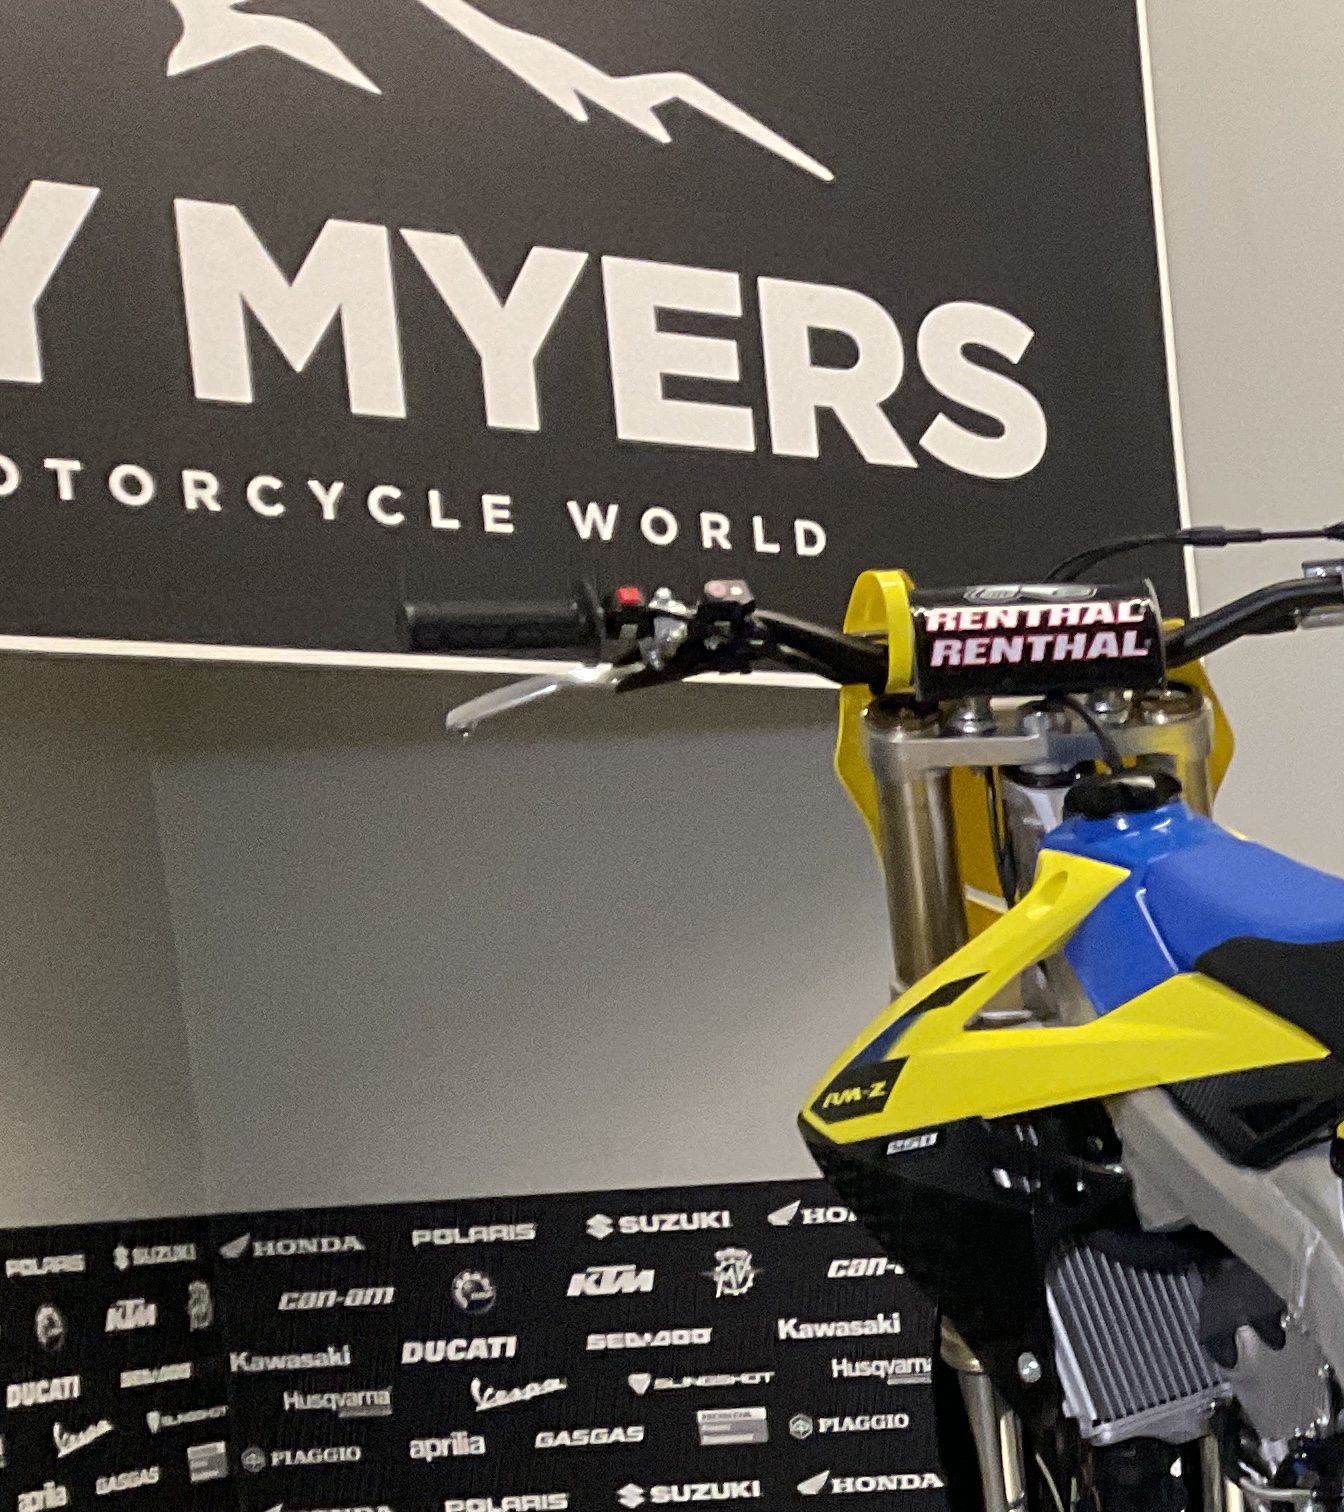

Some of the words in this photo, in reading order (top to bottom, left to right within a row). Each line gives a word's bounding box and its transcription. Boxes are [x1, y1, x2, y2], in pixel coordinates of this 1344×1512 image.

[174, 198, 1047, 480] MYERS
[567, 499, 827, 556] WORLD
[925, 598, 1146, 632] RENTHAL
[930, 631, 1149, 667] RENTHAL
[412, 1223, 536, 1247] POLARIS
[619, 1210, 733, 1233] SUZUKI
[253, 1236, 364, 1256] HONDA
[567, 1264, 655, 1296] KTM
[105, 1298, 156, 1332] KTM
[778, 1312, 901, 1339] Kawasaki
[230, 1345, 351, 1372] Kawasaki
[402, 1335, 517, 1363] DUCATI
[832, 1358, 932, 1380] Husqvarn
[6, 1375, 80, 1408] DUCATI
[284, 1386, 392, 1411] Husqvarna
[818, 1413, 909, 1432] PIAGGIO
[410, 1431, 486, 1462] aprilia
[535, 1426, 644, 1448] GASGAS
[271, 1446, 361, 1466] PIAGGIO
[650, 1480, 761, 1503] SUZUKI
[831, 1473, 944, 1493] HONDA
